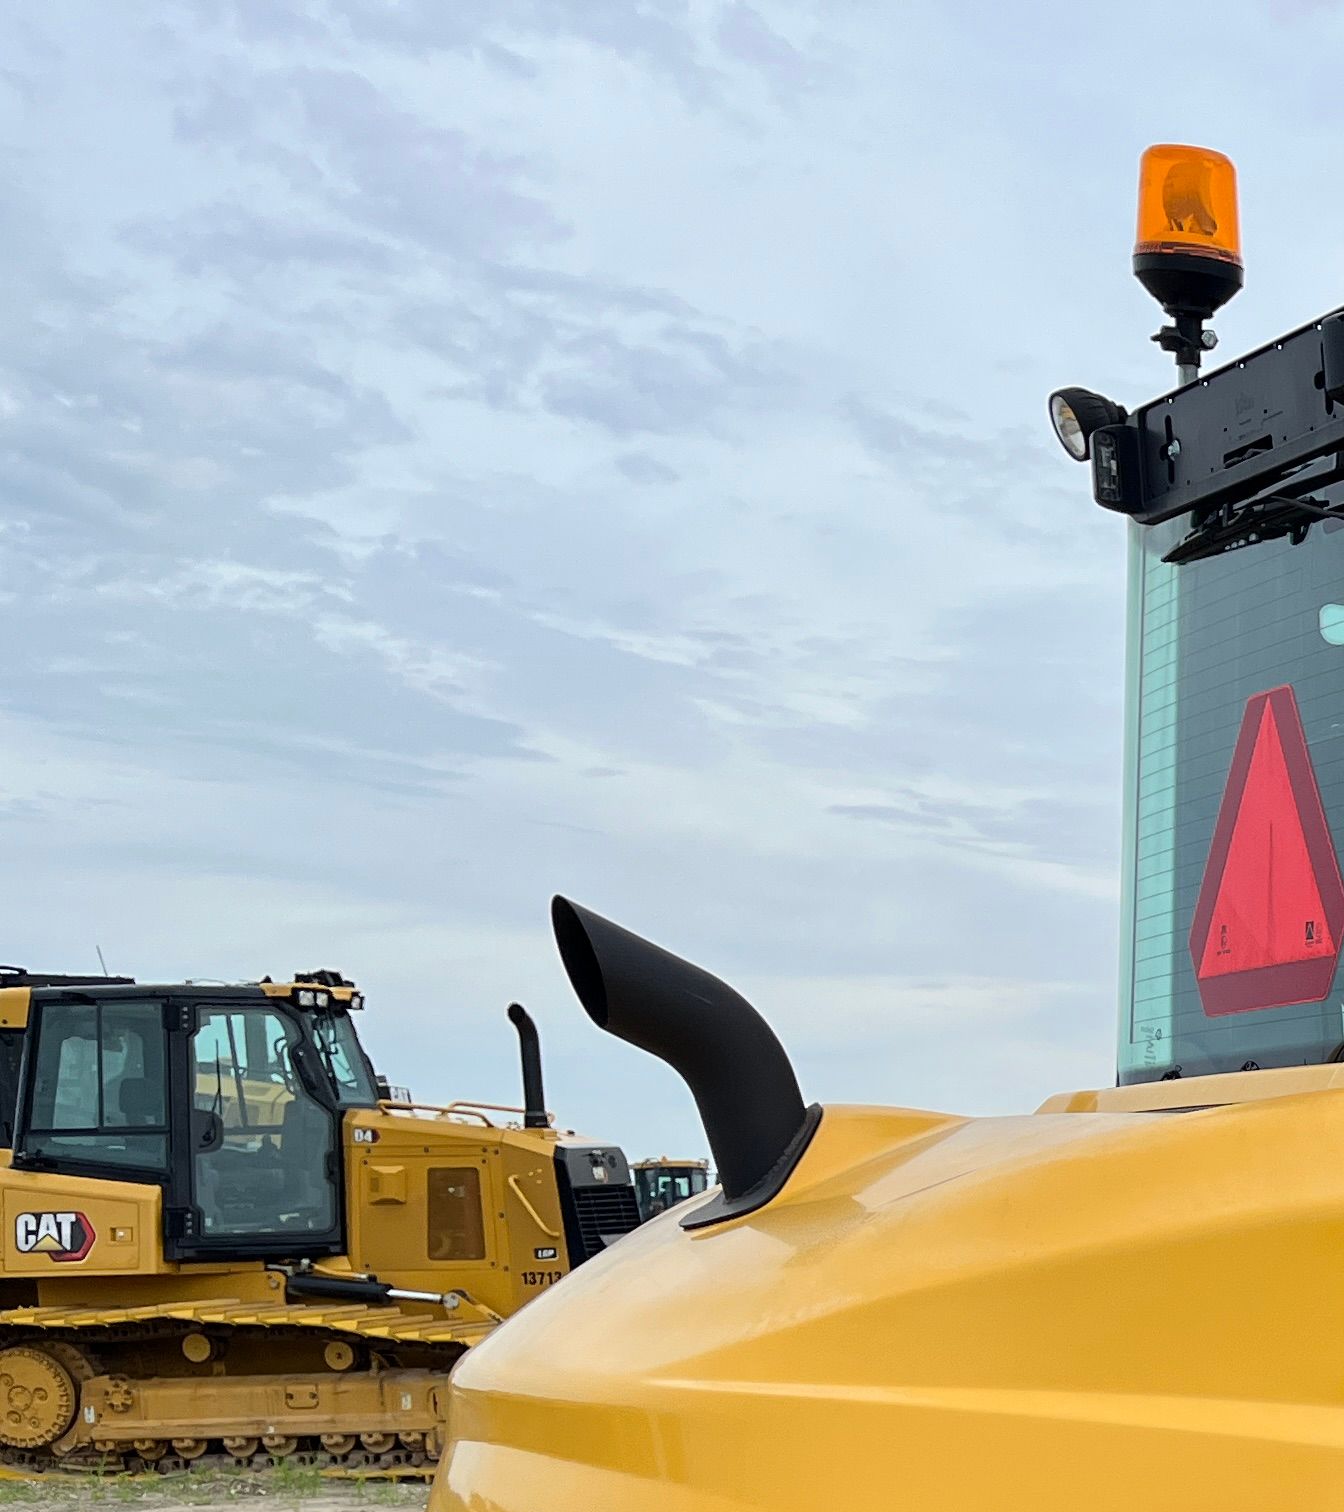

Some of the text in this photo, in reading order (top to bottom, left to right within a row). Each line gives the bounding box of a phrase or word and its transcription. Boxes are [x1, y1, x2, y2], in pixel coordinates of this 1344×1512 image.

[354, 1129, 372, 1142] D4
[16, 1212, 77, 1252] CAT
[521, 1271, 562, 1286] 13713
